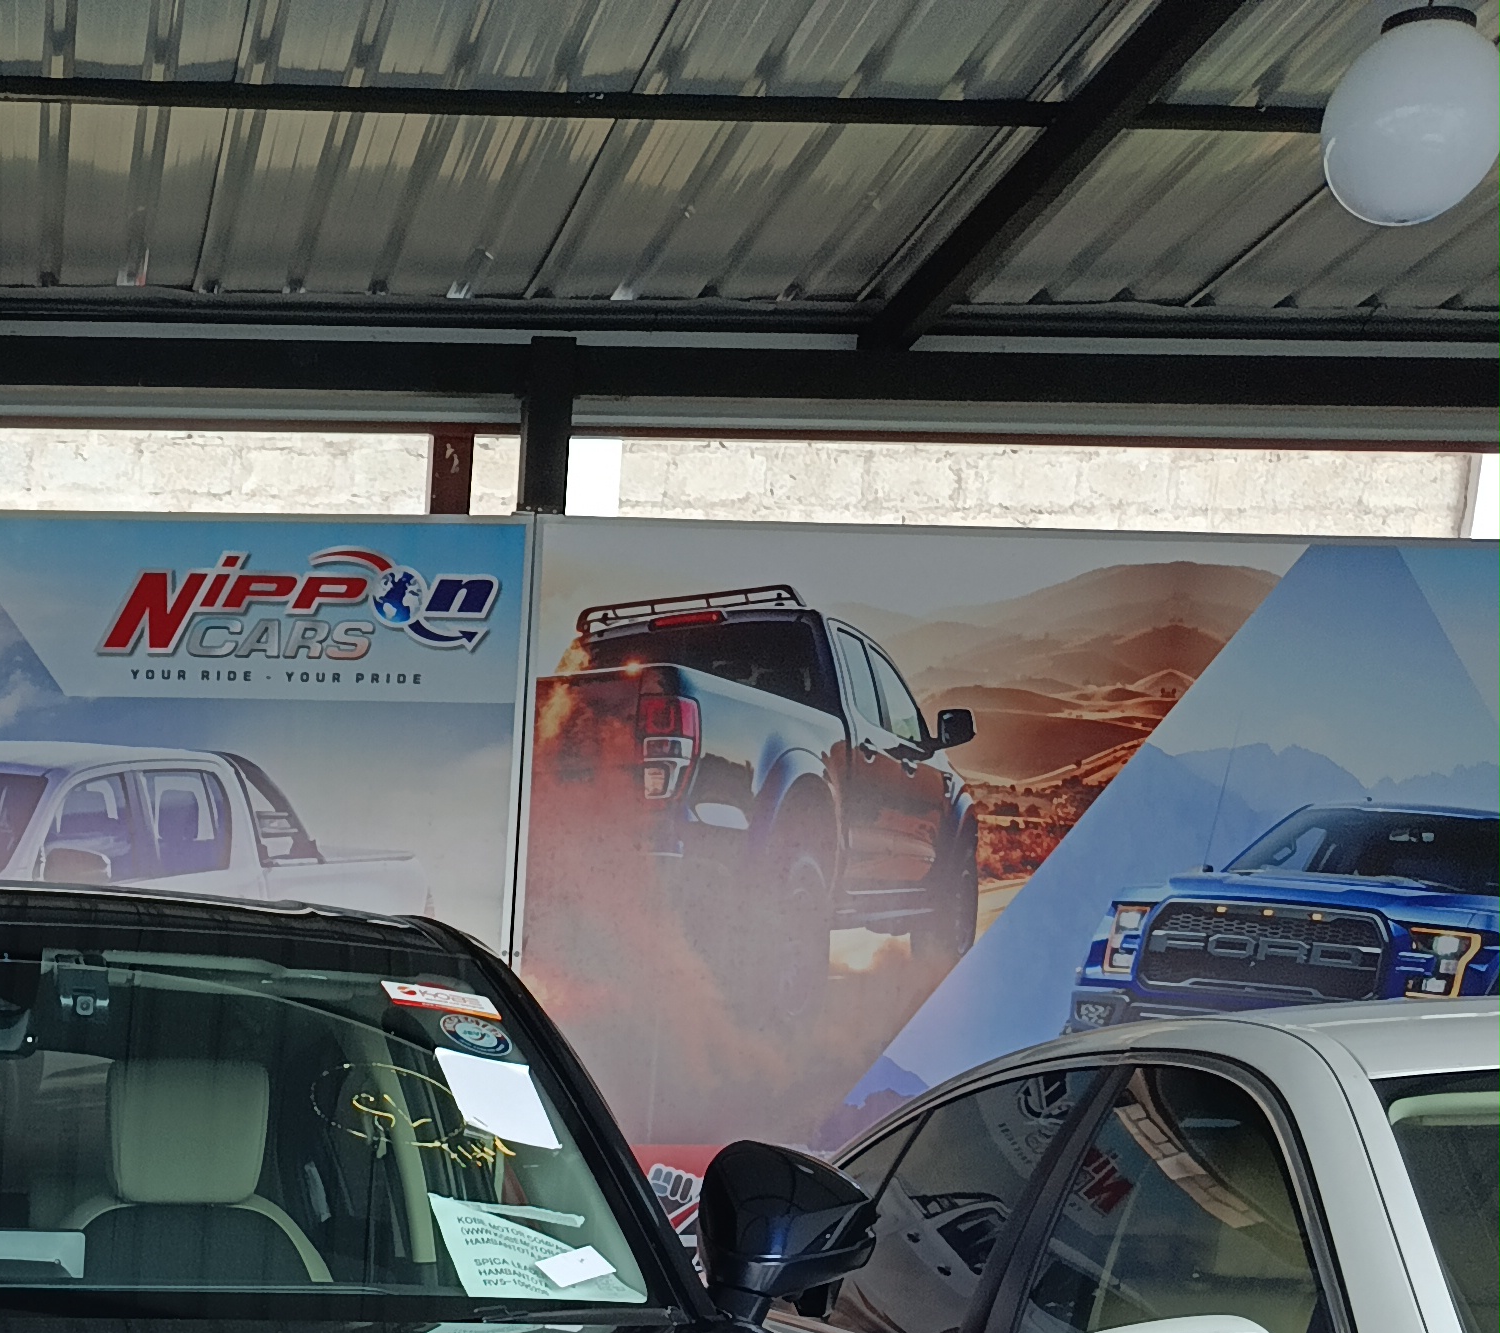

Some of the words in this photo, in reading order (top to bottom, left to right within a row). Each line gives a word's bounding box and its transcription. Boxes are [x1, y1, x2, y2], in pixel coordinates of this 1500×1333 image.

[185, 618, 376, 660] CARS
[130, 669, 187, 681] YOUR
[201, 670, 253, 682] RIDE
[285, 671, 341, 684] YOUR
[355, 672, 422, 685] PRIDE
[1148, 930, 1364, 968] FORD
